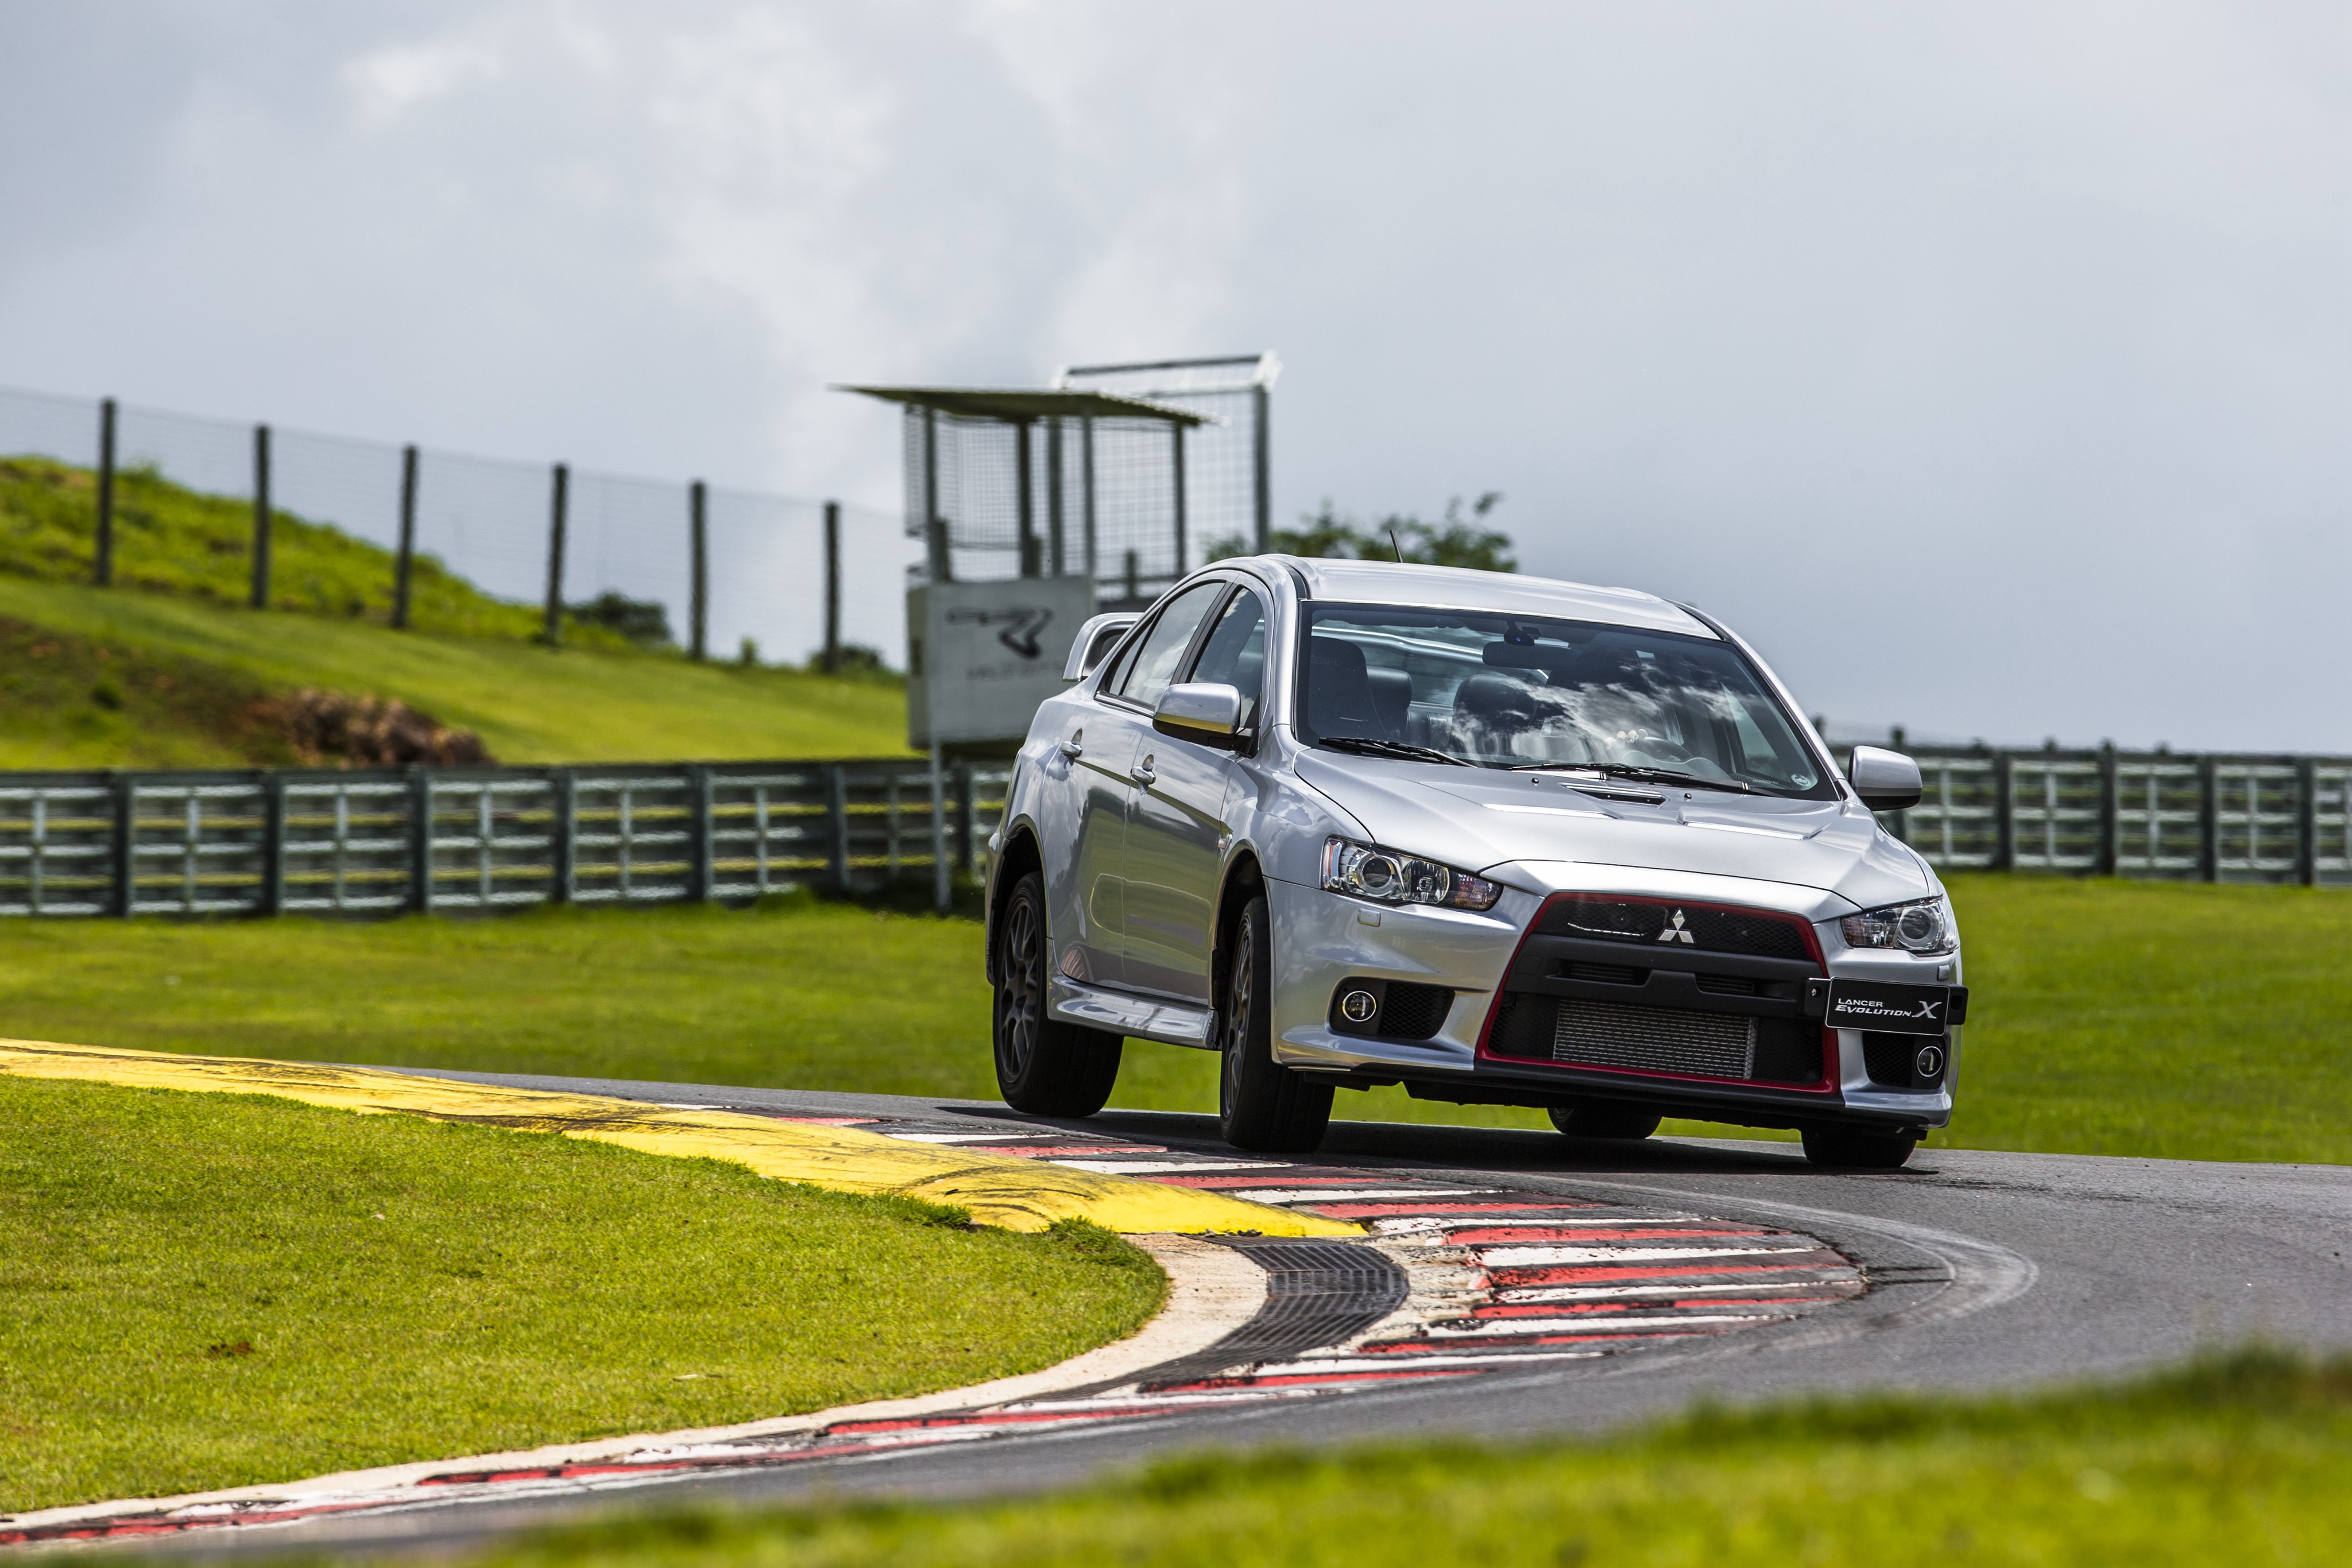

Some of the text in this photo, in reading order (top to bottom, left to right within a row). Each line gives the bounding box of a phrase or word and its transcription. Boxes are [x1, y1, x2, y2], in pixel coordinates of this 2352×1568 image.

[1838, 998, 1883, 1007] LANCER
[1835, 1001, 1942, 1019] EVOLUTION X
